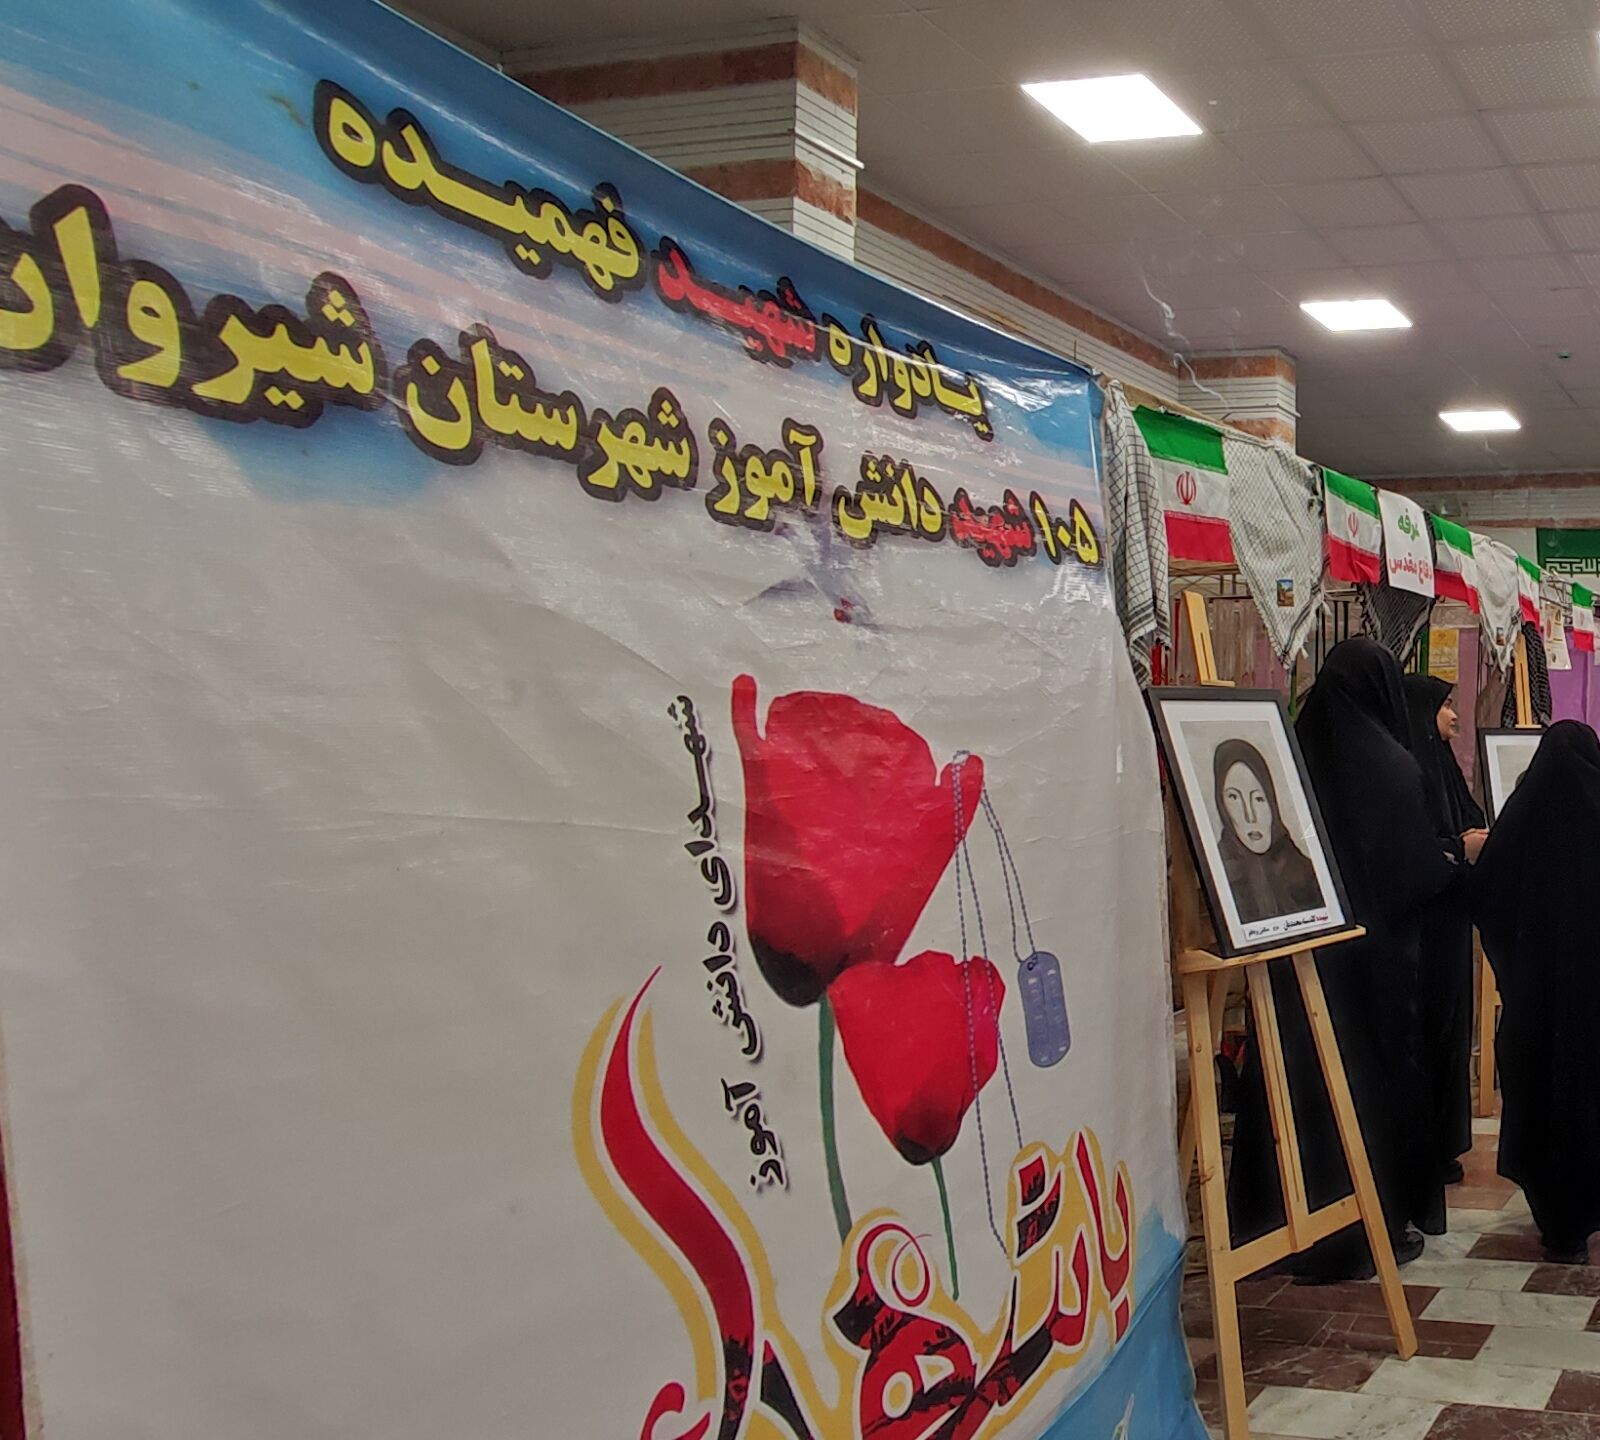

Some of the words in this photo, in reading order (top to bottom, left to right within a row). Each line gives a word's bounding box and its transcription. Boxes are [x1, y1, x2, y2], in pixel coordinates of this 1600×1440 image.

[322, 88, 643, 294] فهمیده
[652, 246, 818, 362] شهید
[402, 335, 694, 492] شهرستان
[825, 317, 988, 436] یادواره
[712, 425, 817, 522] آموز
[836, 455, 944, 543] دانش
[946, 488, 1036, 564] شهید
[667, 693, 738, 906] شهدای
[702, 921, 762, 1058] دانش
[720, 1078, 786, 1190] آموز
